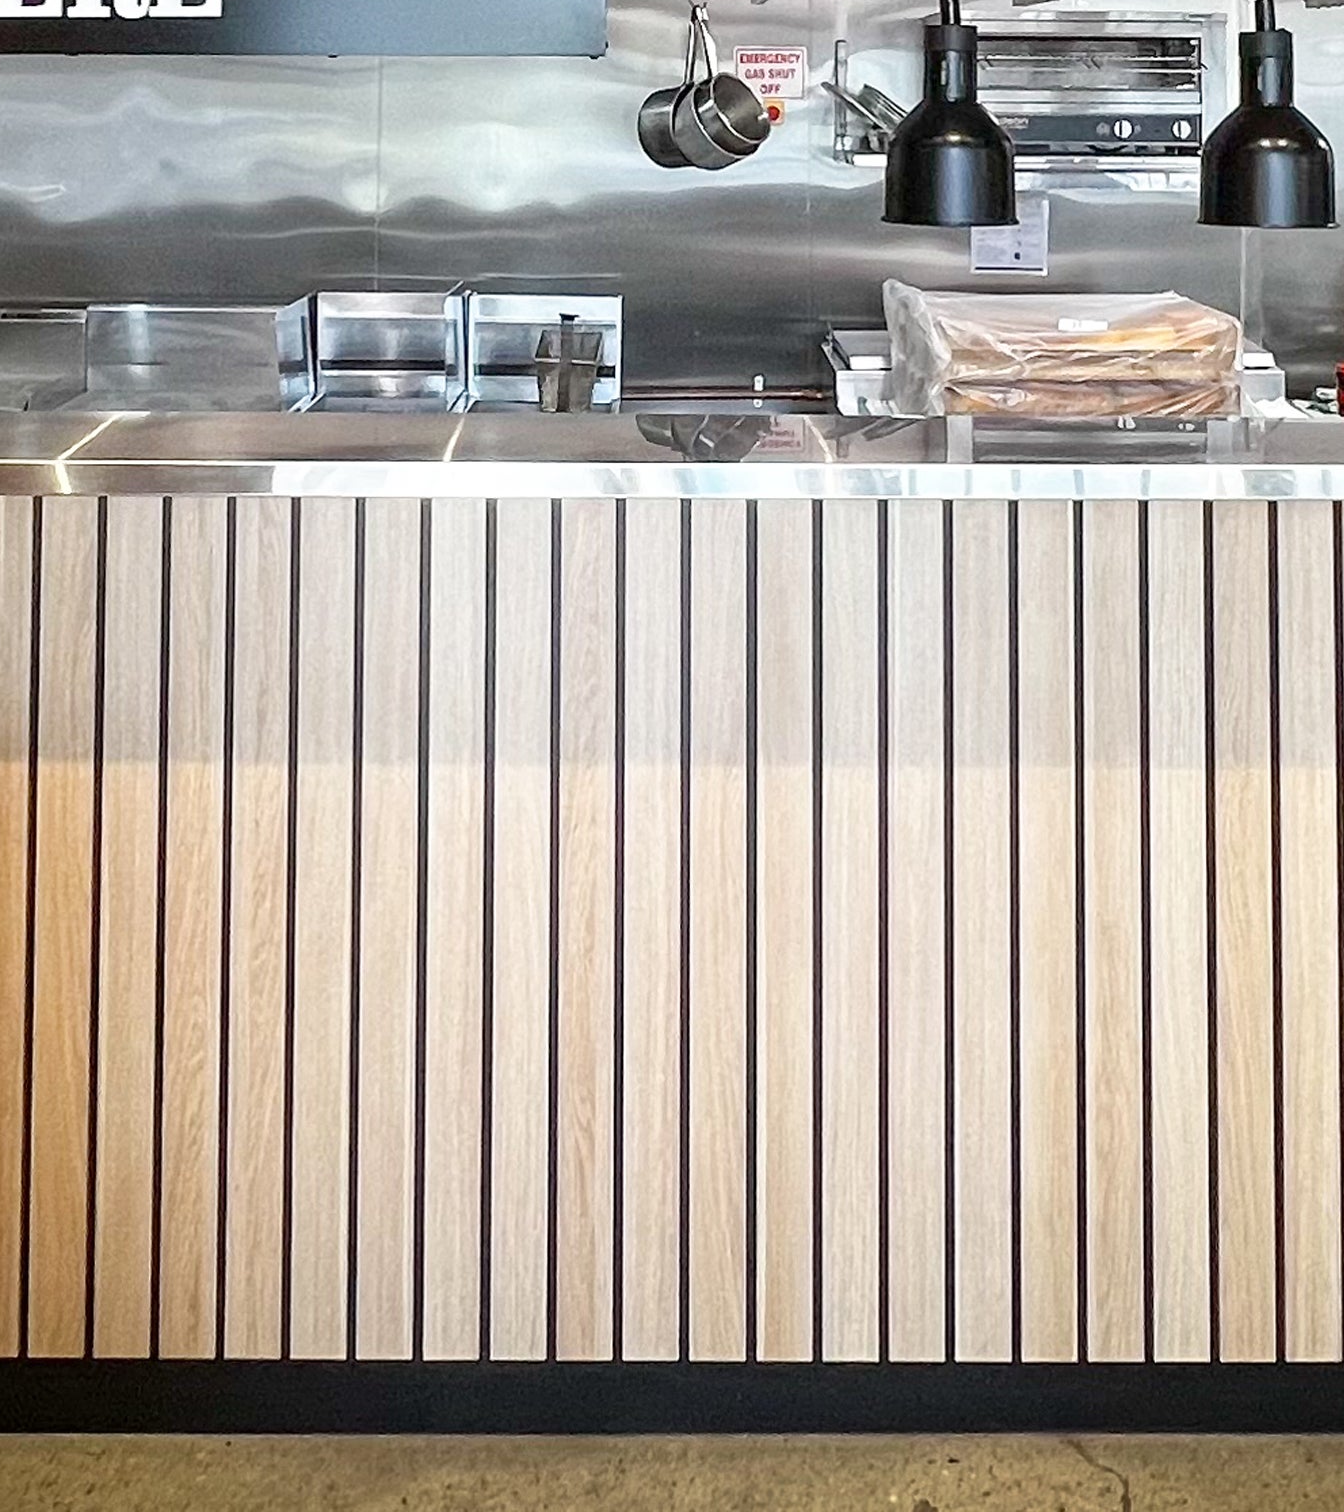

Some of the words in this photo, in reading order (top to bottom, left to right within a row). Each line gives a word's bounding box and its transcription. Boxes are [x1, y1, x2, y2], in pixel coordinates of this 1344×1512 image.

[744, 68, 765, 80] GAS
[768, 68, 796, 79] SHUT
[759, 83, 782, 95] OFF
